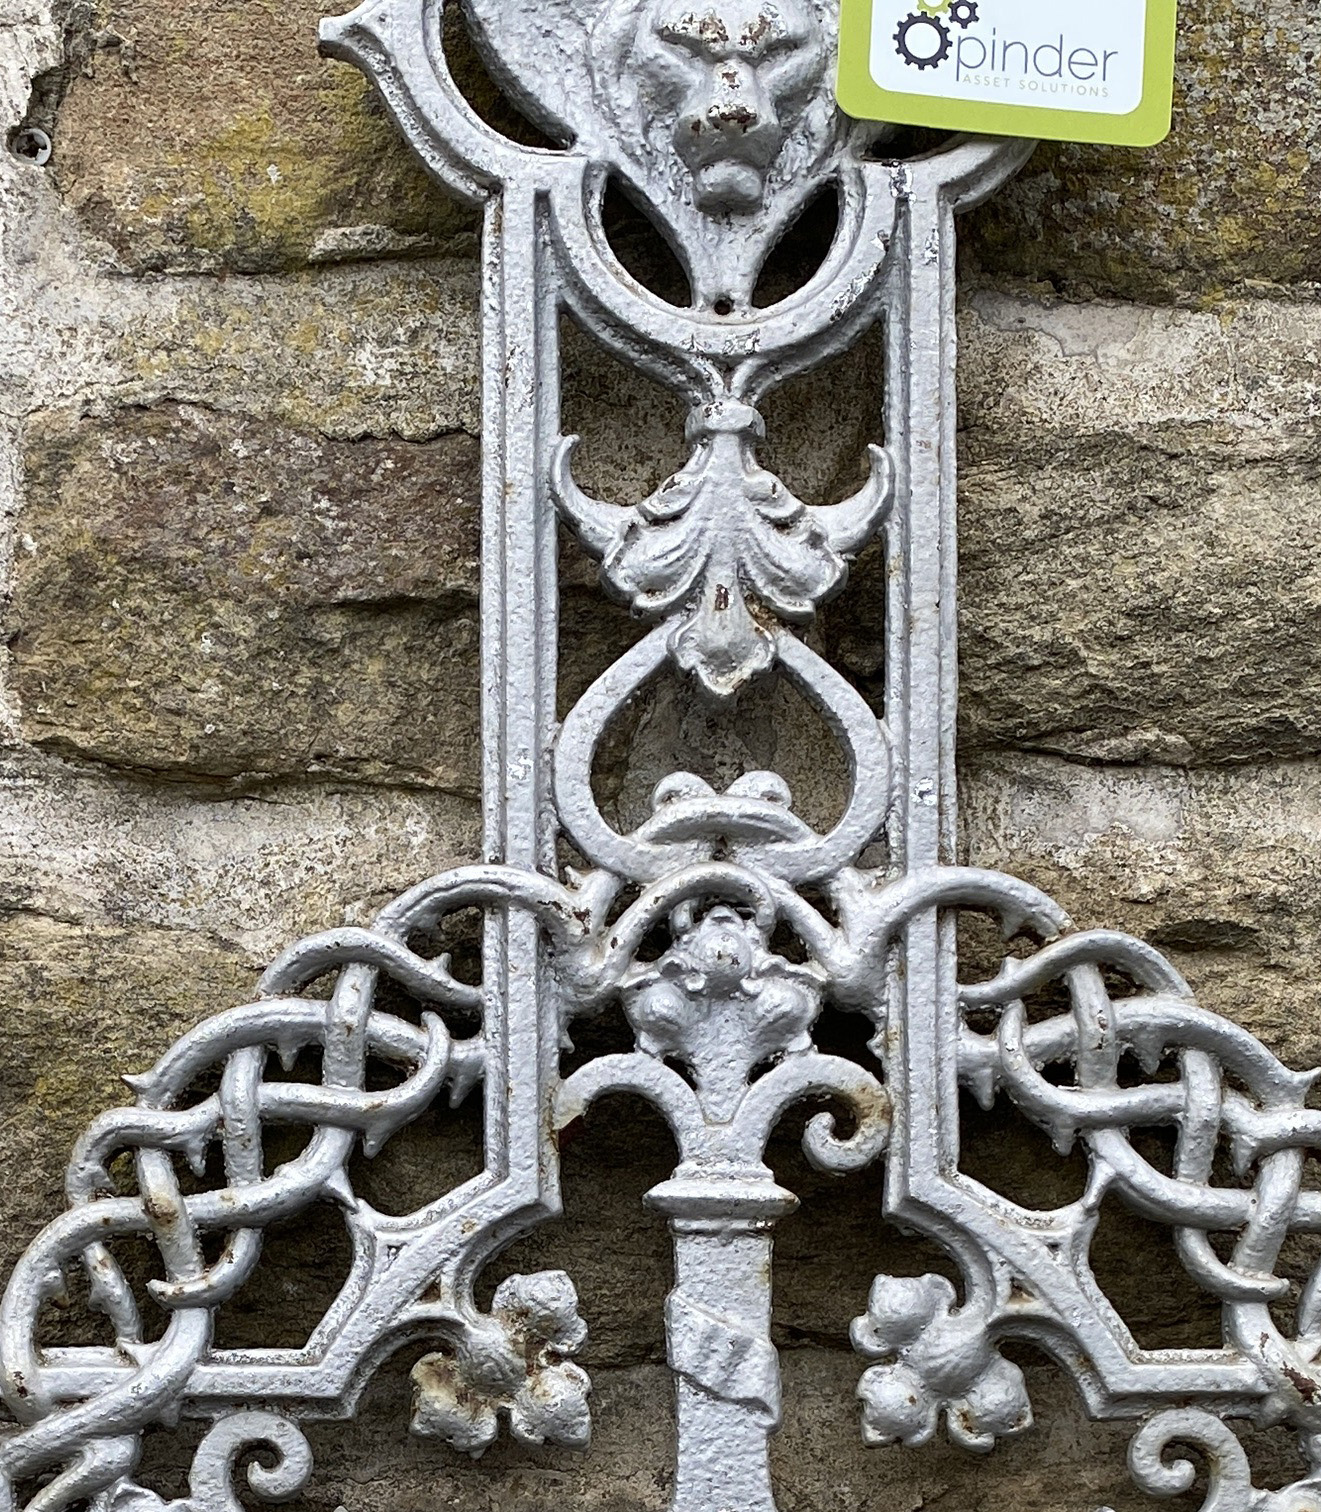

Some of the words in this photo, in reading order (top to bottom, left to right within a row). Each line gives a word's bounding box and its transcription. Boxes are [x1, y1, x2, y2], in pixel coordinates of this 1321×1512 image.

[956, 27, 1118, 82] pinder
[961, 73, 1010, 88] ASSET
[1018, 78, 1109, 98] SOLUTIONS
